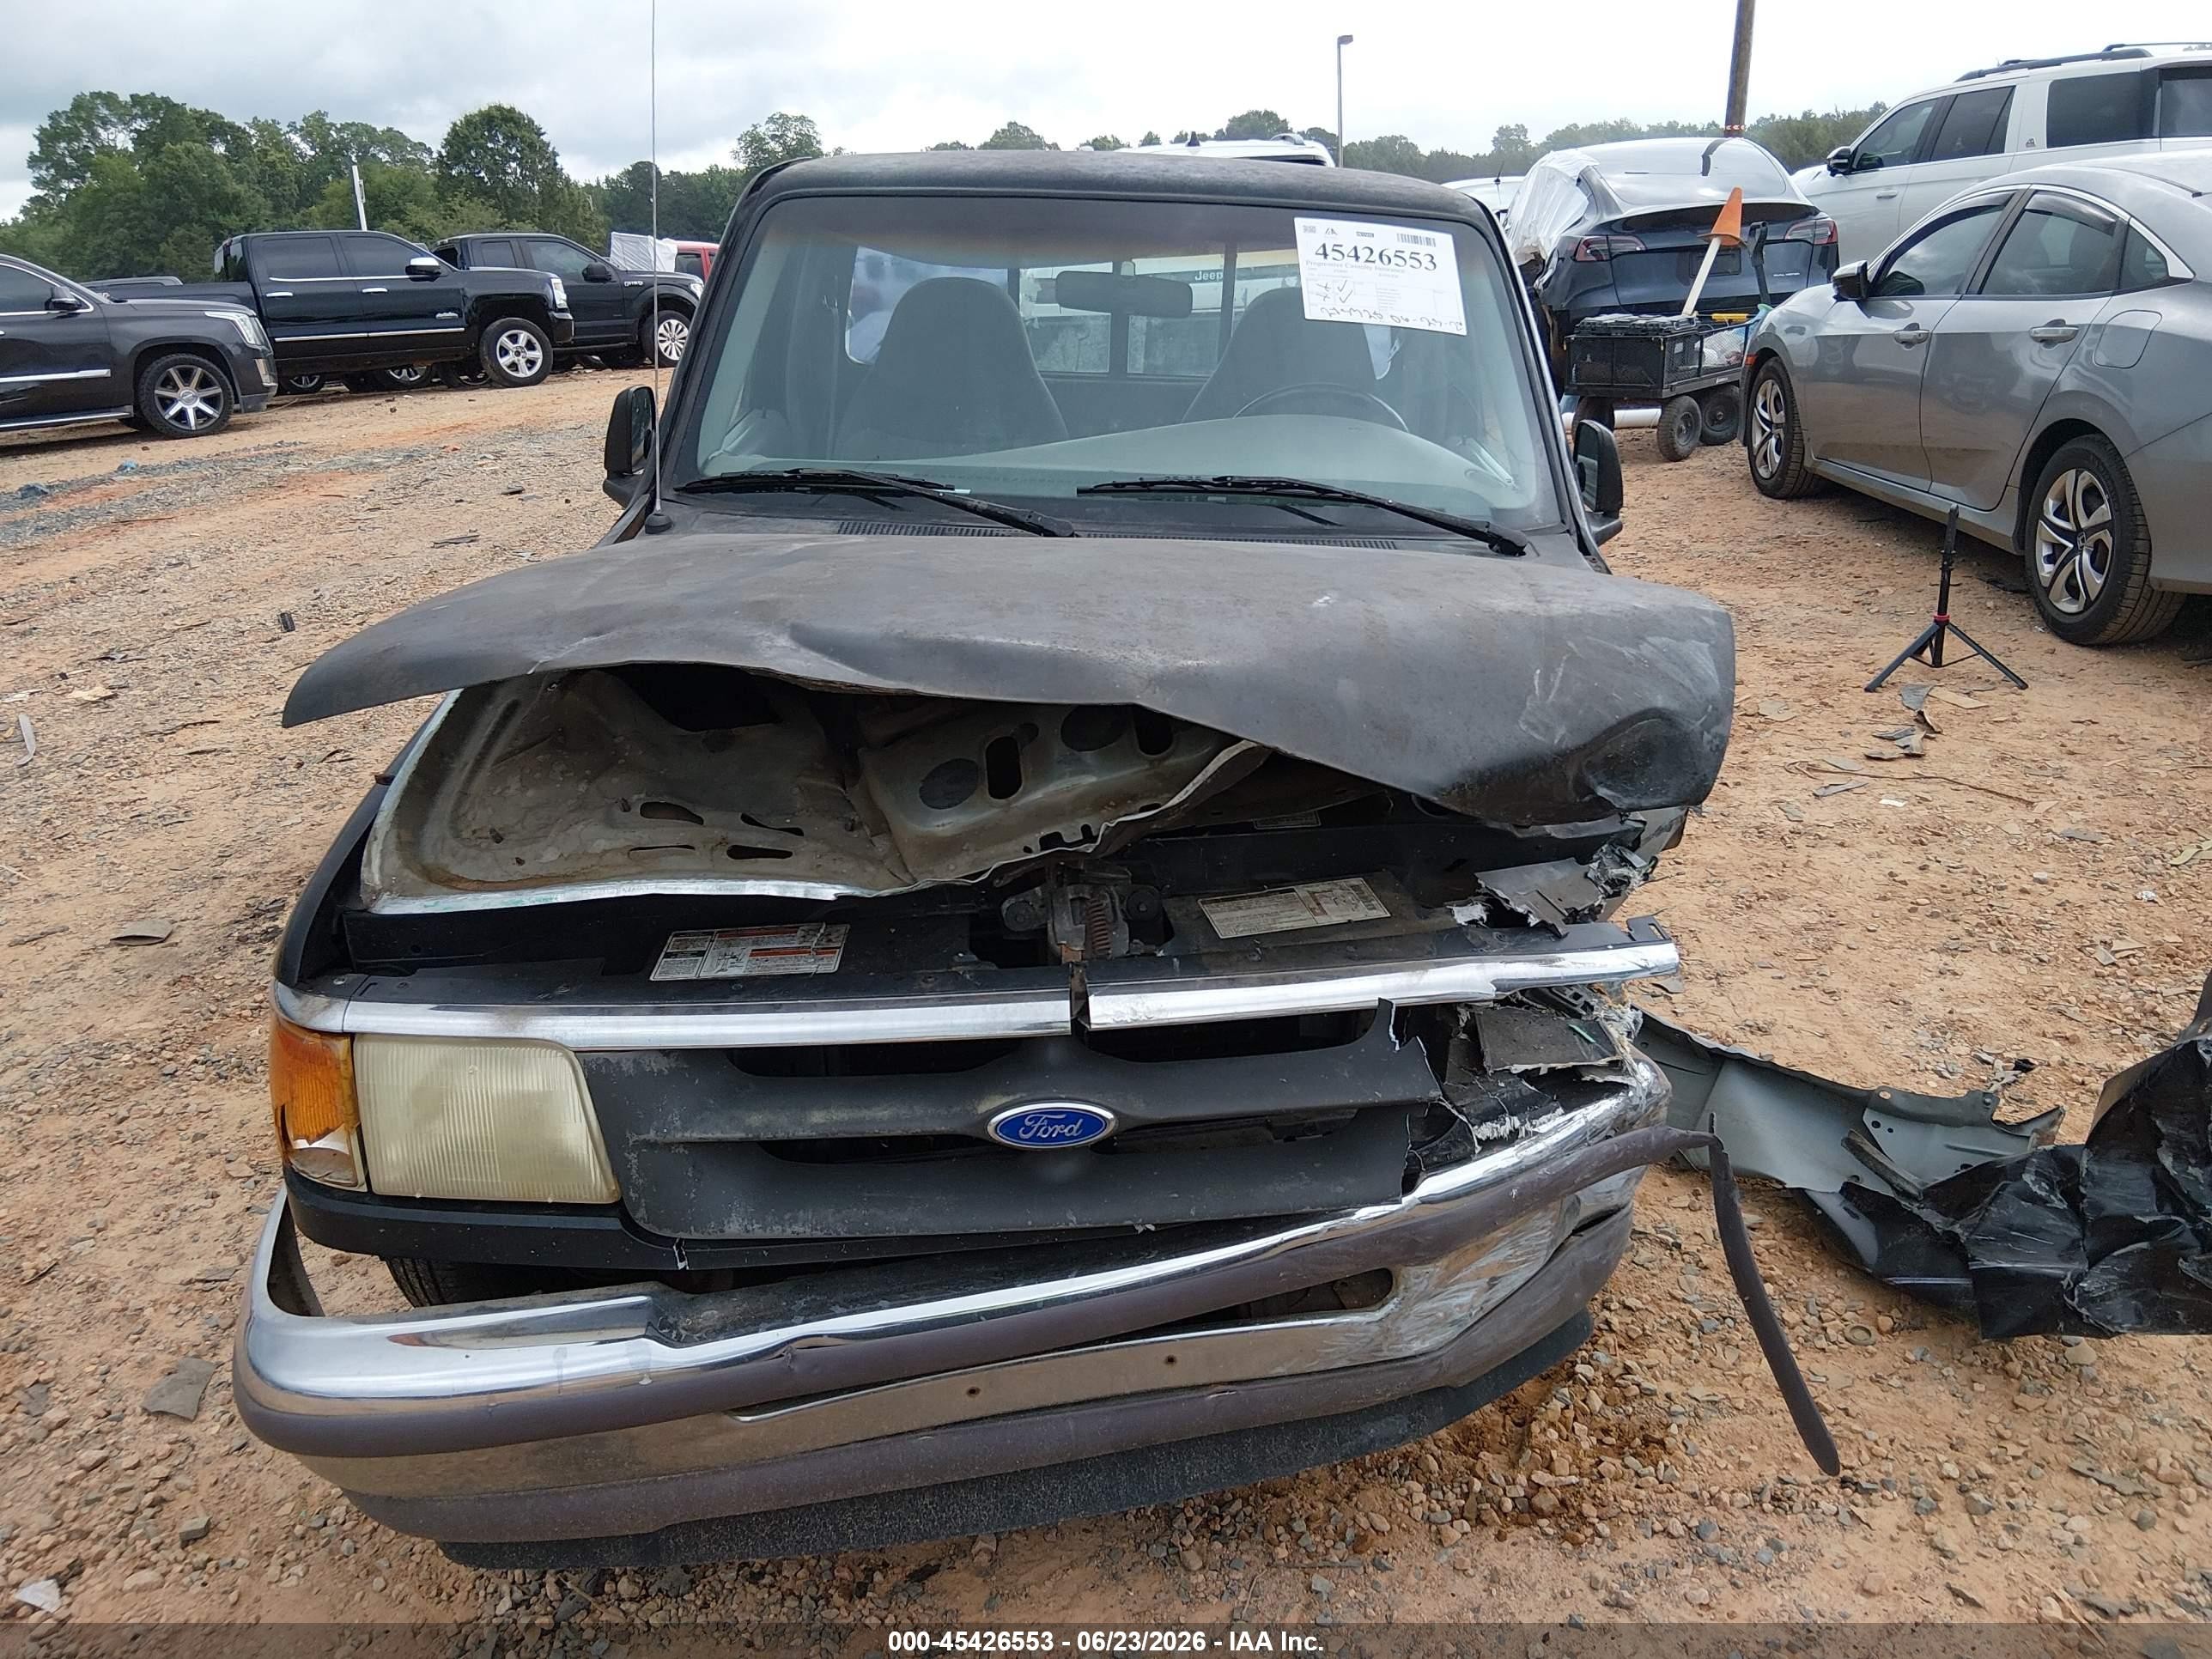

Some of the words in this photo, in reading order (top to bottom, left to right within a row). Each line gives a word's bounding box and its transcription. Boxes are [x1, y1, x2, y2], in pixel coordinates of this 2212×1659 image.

[1315, 242, 1437, 271] 45426553
[1194, 270, 1224, 282] Jeep
[1018, 1114, 1084, 1139] Ford
